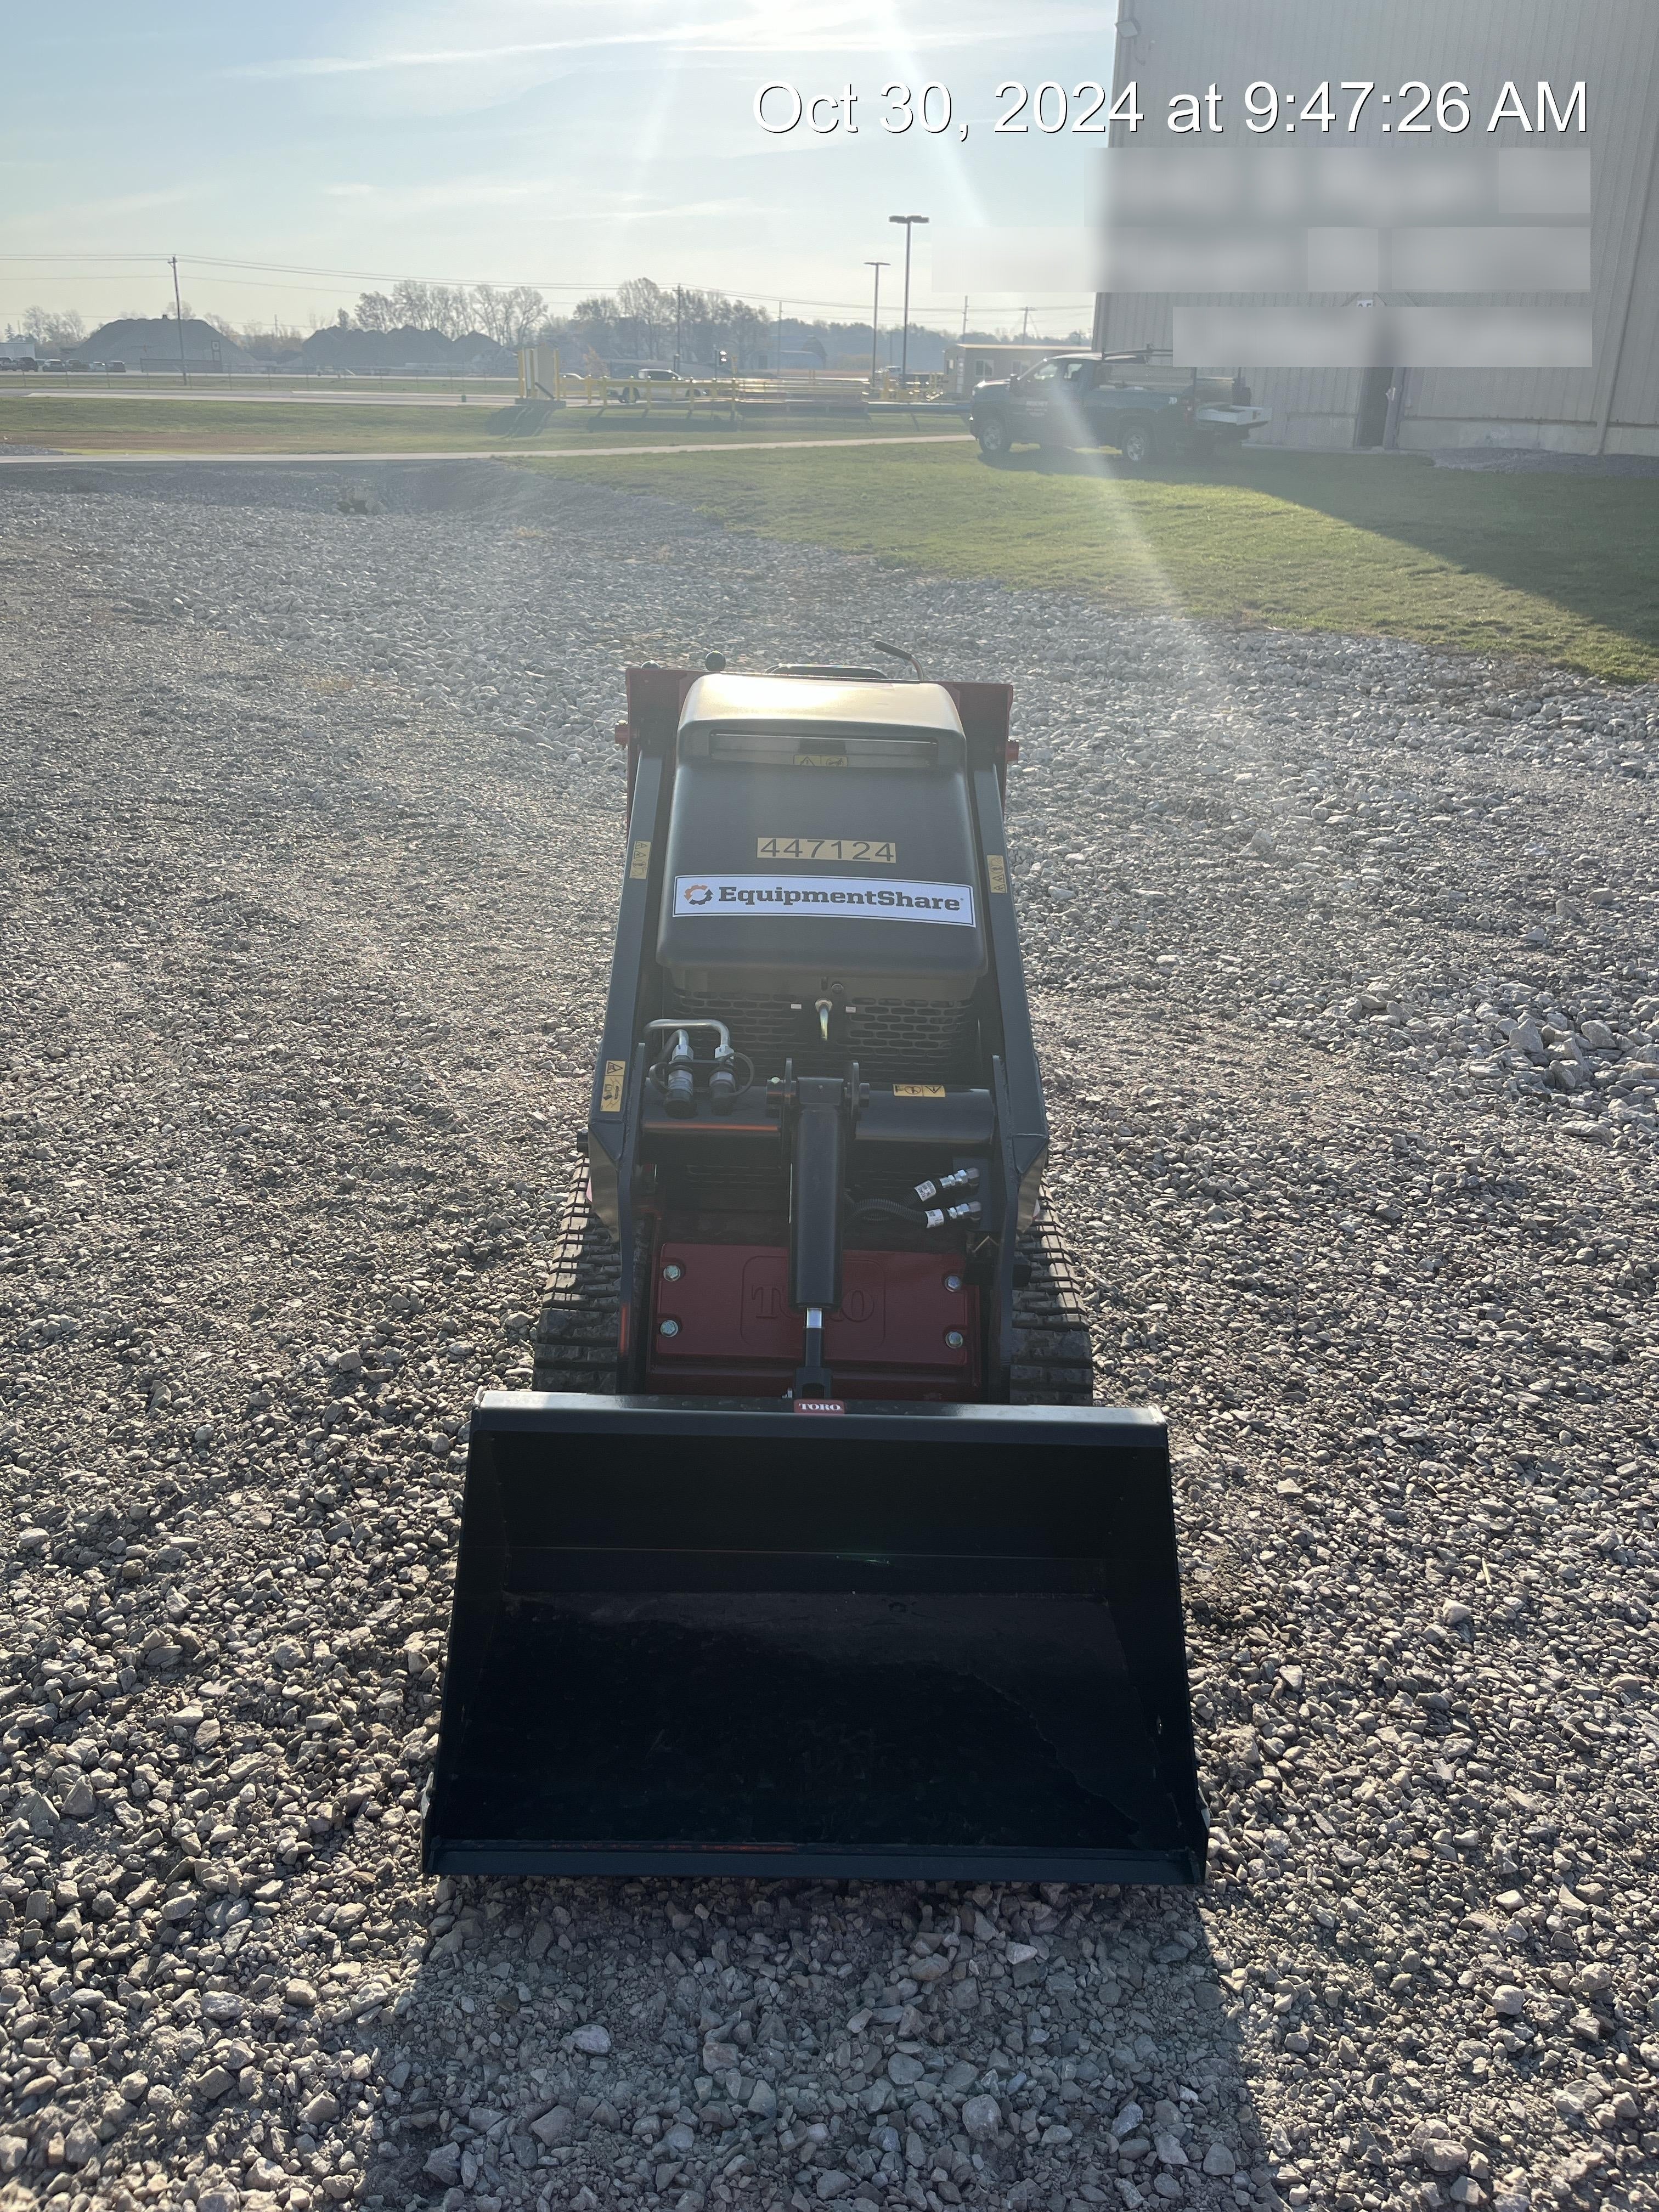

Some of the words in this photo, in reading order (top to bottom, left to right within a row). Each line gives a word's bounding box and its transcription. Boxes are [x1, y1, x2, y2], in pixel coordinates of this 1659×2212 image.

[760, 838, 894, 862] 447124
[719, 886, 961, 911] EquipmentShare
[798, 1402, 842, 1411] TORO
